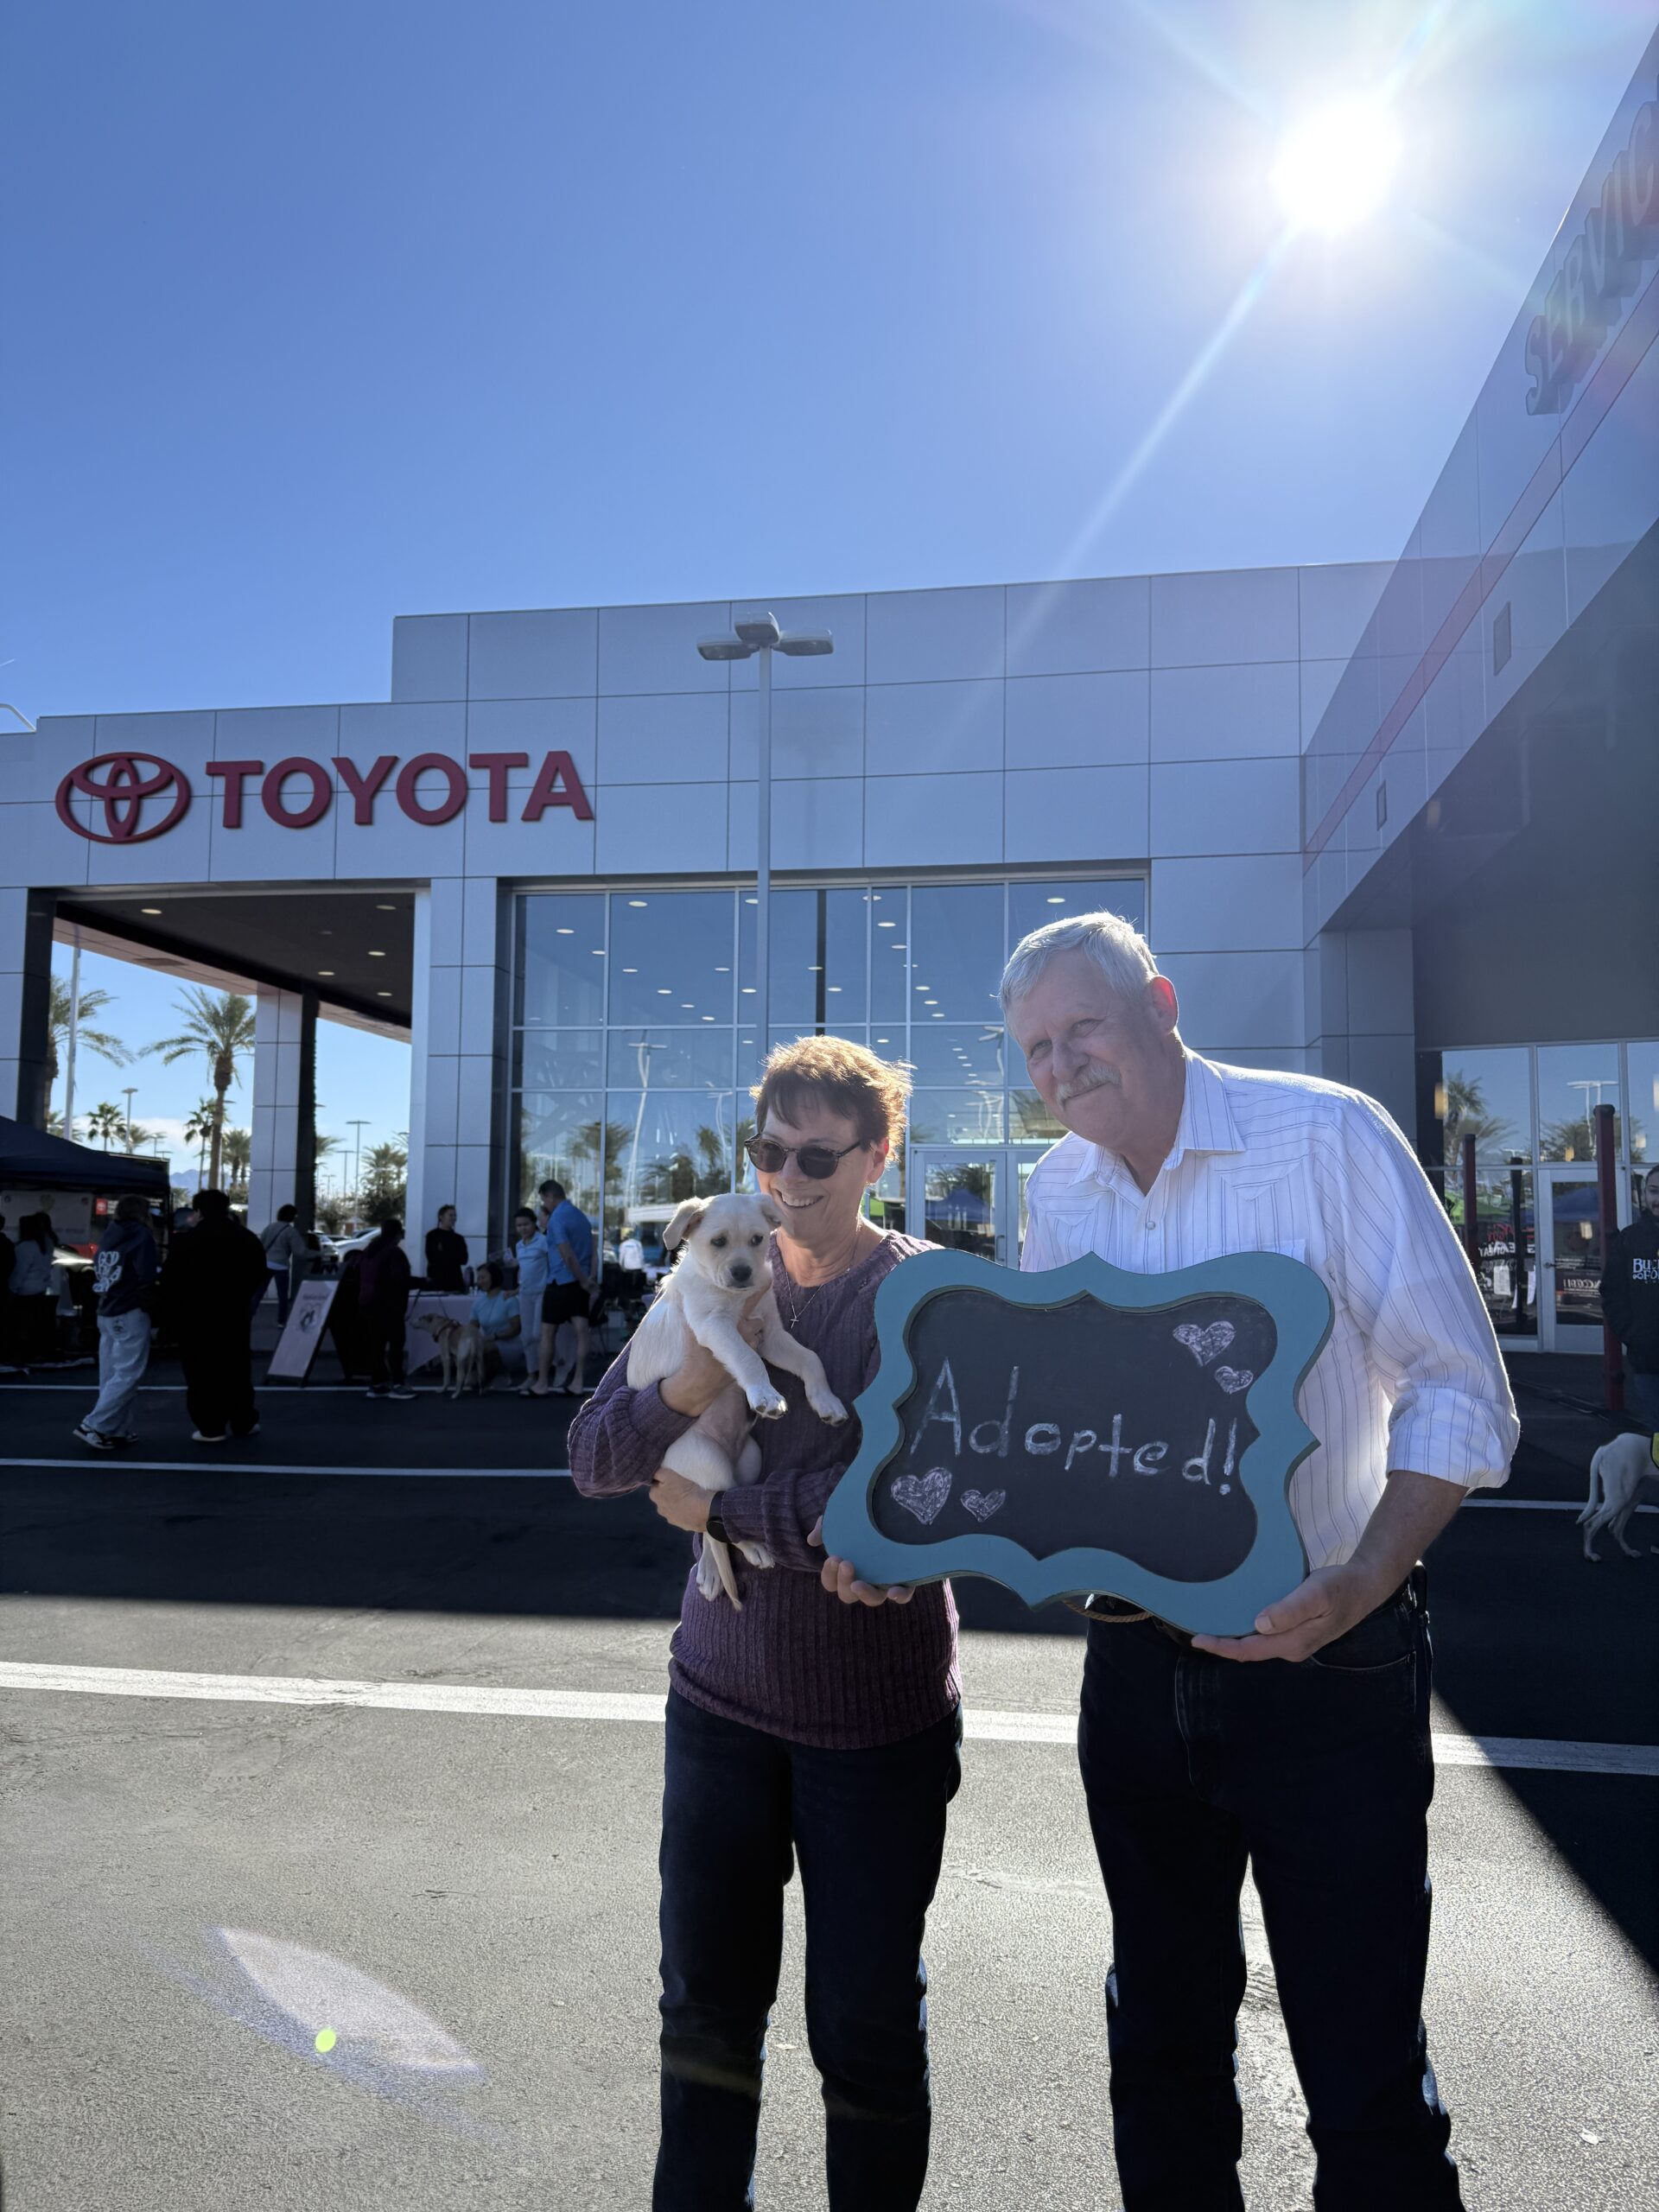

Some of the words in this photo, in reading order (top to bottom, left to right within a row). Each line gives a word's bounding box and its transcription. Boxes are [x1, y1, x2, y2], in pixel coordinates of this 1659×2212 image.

[1525, 74, 1659, 416] SERVIC
[206, 750, 594, 830] TOYOTA
[1643, 1269, 1659, 1281] FO
[909, 1356, 1238, 1496] Adopted!
